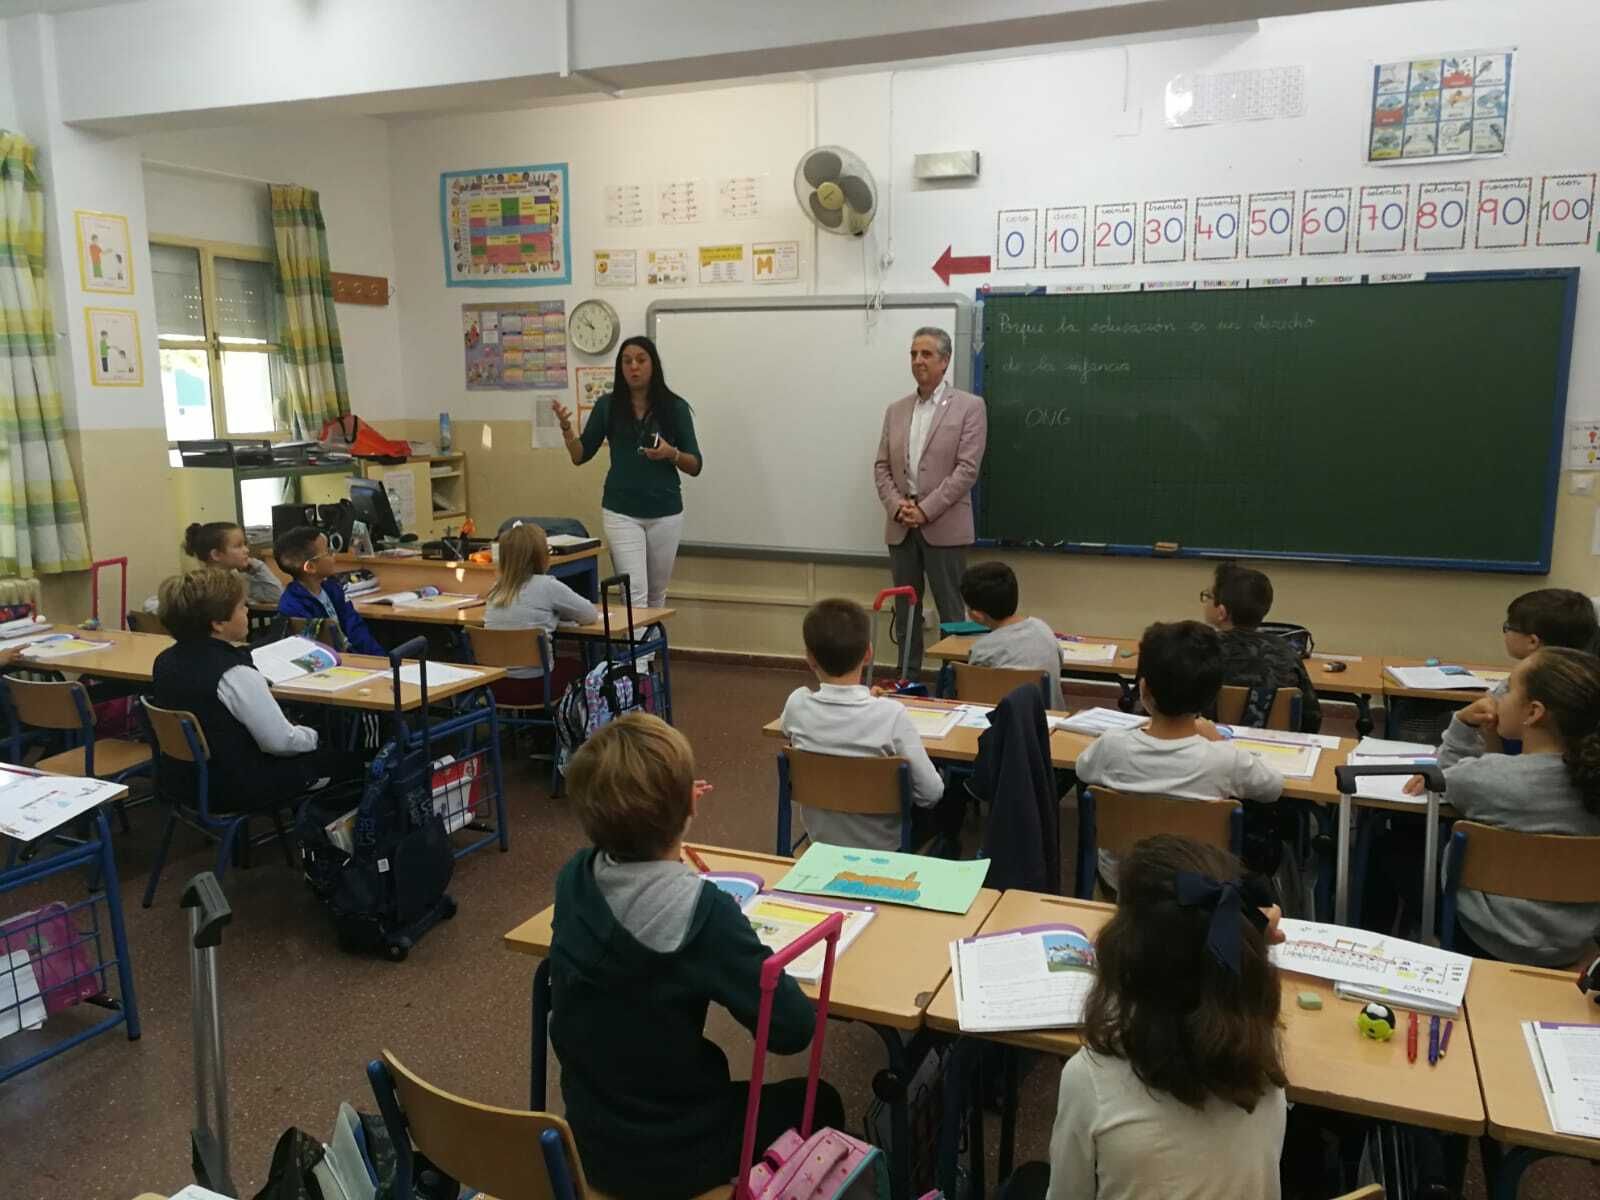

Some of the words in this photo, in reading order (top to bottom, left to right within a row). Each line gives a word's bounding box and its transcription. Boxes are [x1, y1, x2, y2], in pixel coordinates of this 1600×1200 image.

[1251, 207, 1290, 236] 50
[1302, 206, 1346, 234] 60
[1360, 202, 1404, 231] 70
[1417, 200, 1464, 229] 80
[1479, 197, 1526, 226] 90
[1540, 197, 1589, 222] 100
[1048, 227, 1079, 254] 10
[1096, 220, 1133, 246] 20
[1145, 217, 1183, 245] 30
[1196, 213, 1236, 240] 40
[1005, 231, 1025, 258] 0
